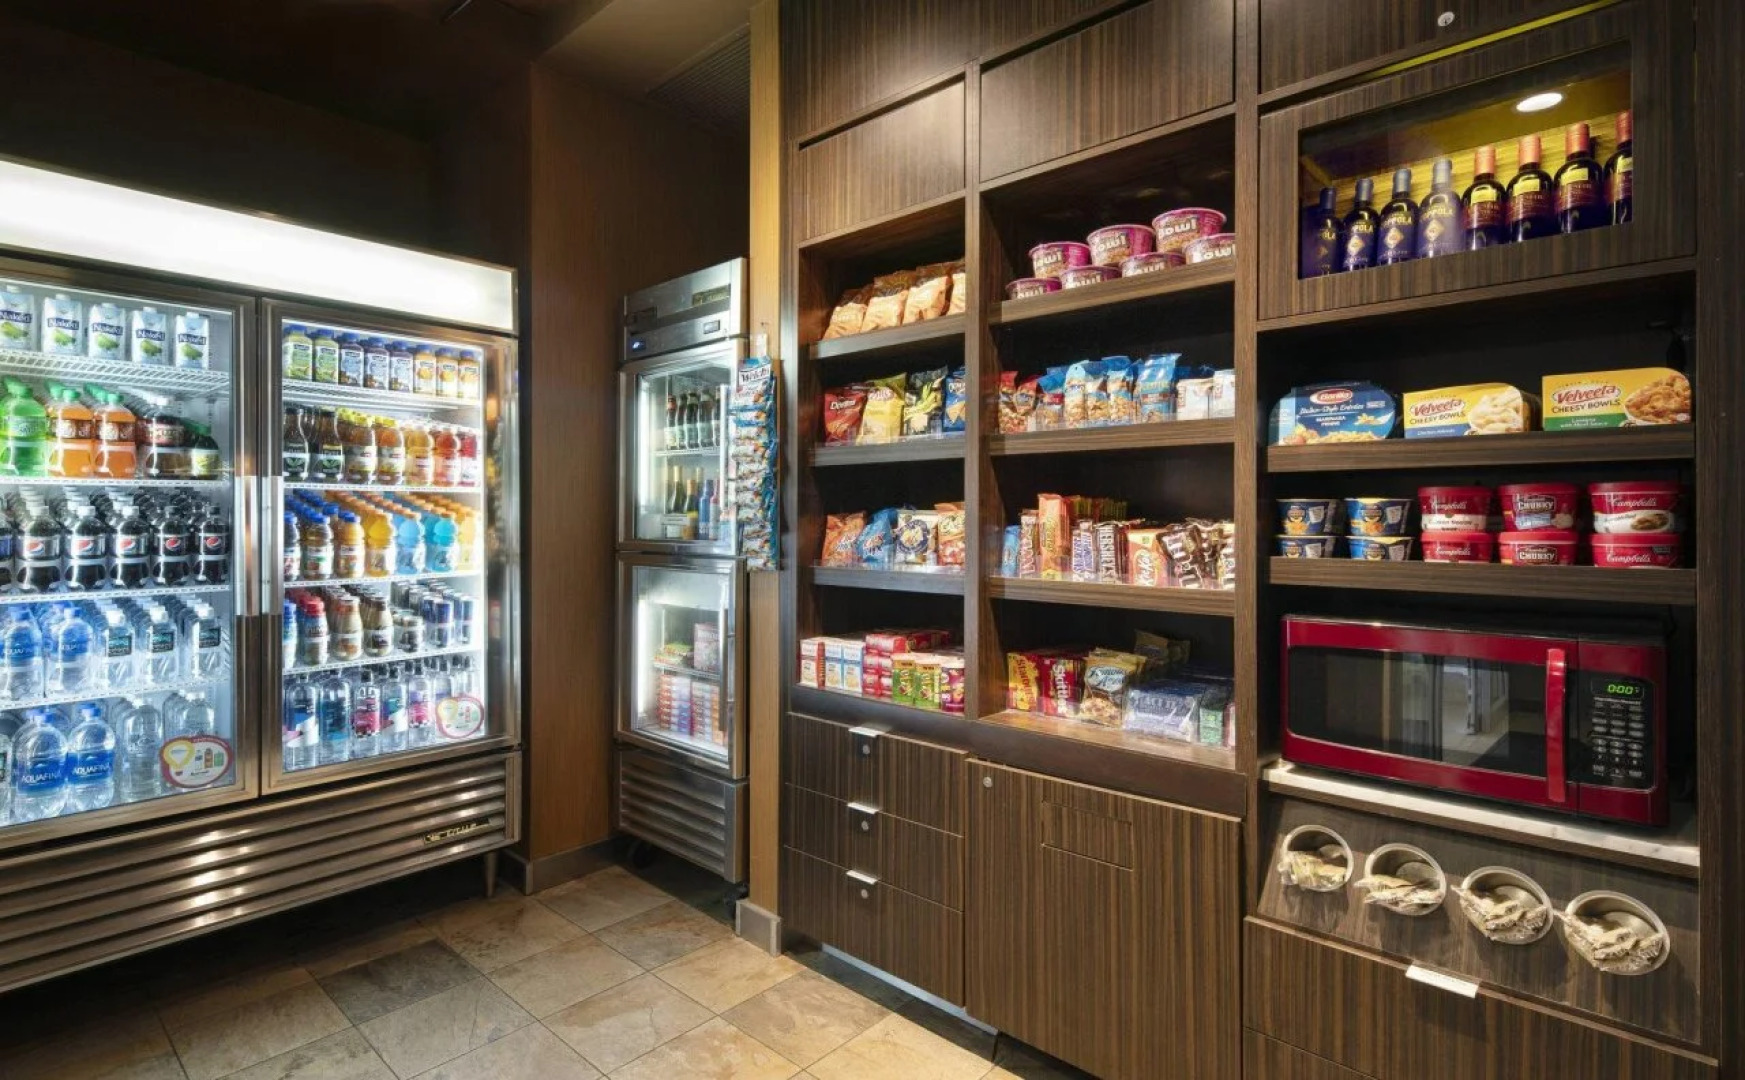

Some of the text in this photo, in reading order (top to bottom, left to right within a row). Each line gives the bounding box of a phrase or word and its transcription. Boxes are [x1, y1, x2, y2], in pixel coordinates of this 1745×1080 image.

[1558, 386, 1616, 404] Velveeta
[1414, 399, 1462, 416] Velveeta
[1552, 399, 1621, 413] CHEESY BOWLS
[1410, 411, 1466, 425] CHEESY BOWLS
[1518, 501, 1555, 511] CHUNKY
[1519, 551, 1555, 561] CHUNKY
[1053, 663, 1070, 714] Skittles
[72, 762, 111, 775] AQUAFINA
[21, 770, 62, 784] AQUAFINA
